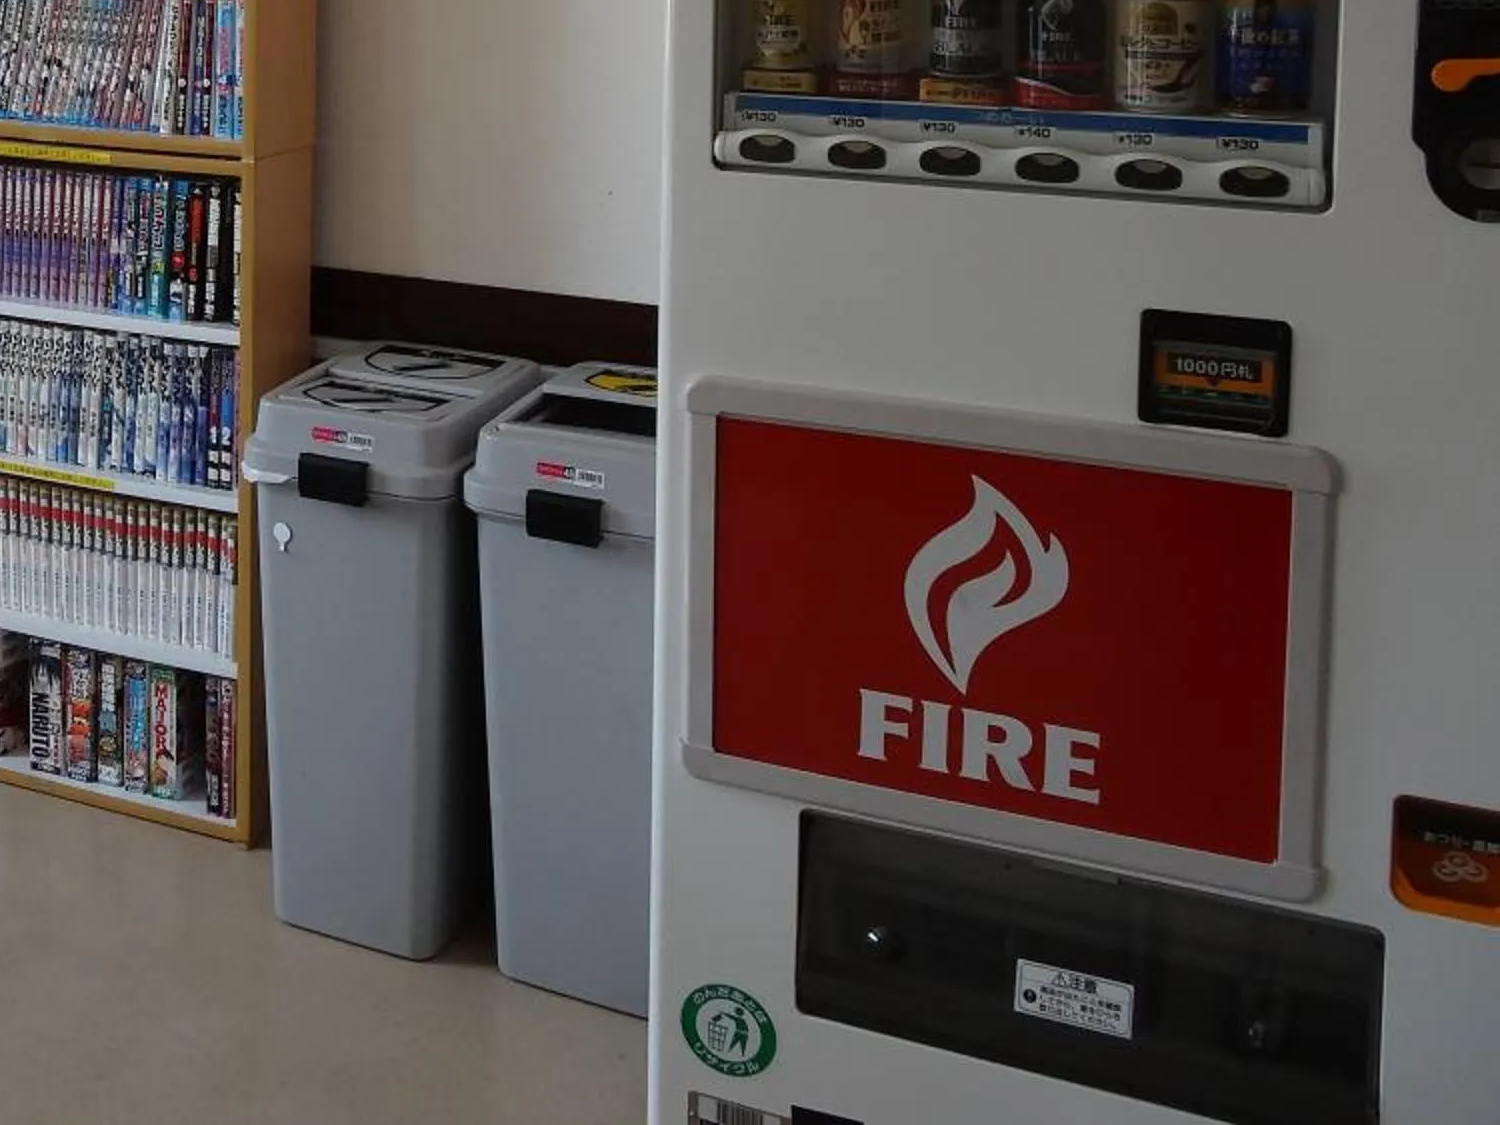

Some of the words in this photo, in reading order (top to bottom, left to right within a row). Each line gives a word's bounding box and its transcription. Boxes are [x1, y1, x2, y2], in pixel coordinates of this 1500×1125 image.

[31, 692, 51, 760] NARUTO
[153, 683, 169, 755] MAJOR
[857, 688, 1100, 805] FIRE
